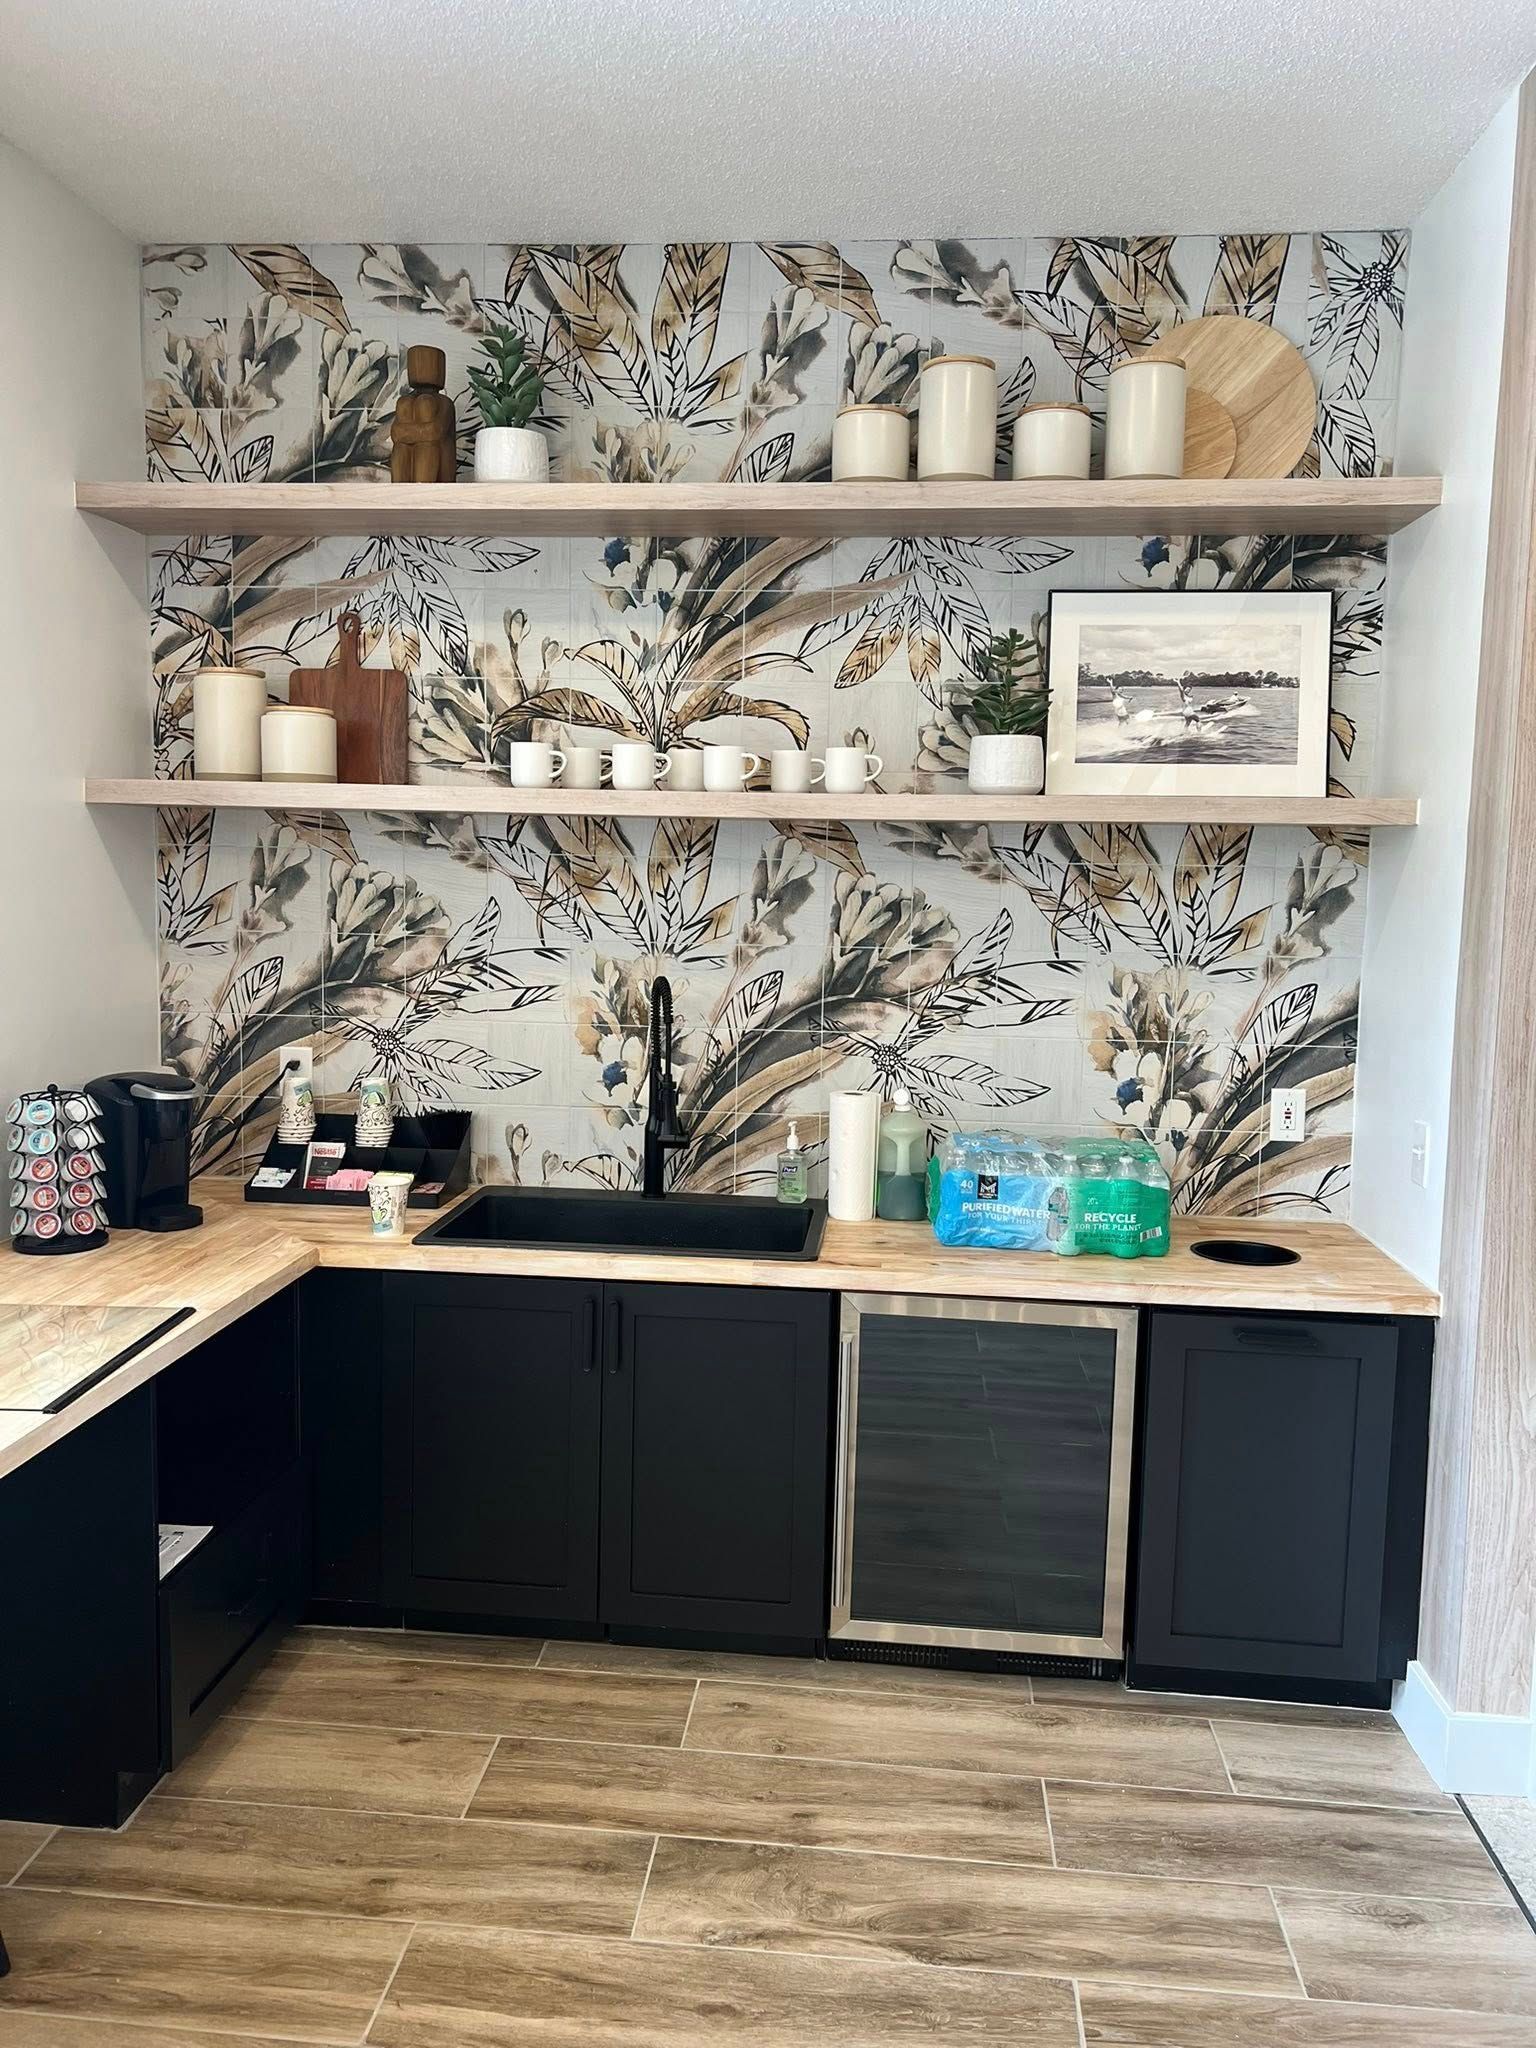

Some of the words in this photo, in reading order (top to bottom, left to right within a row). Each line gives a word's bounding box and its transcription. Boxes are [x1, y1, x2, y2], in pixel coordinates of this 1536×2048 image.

[960, 1180, 974, 1189] 40
[962, 1201, 1012, 1215] PURIFIED
[1010, 1206, 1051, 1220] WATER
[984, 1211, 1009, 1223] YOUR
[1084, 1212, 1137, 1224] RECYCLE
[1092, 1223, 1111, 1232] THE
